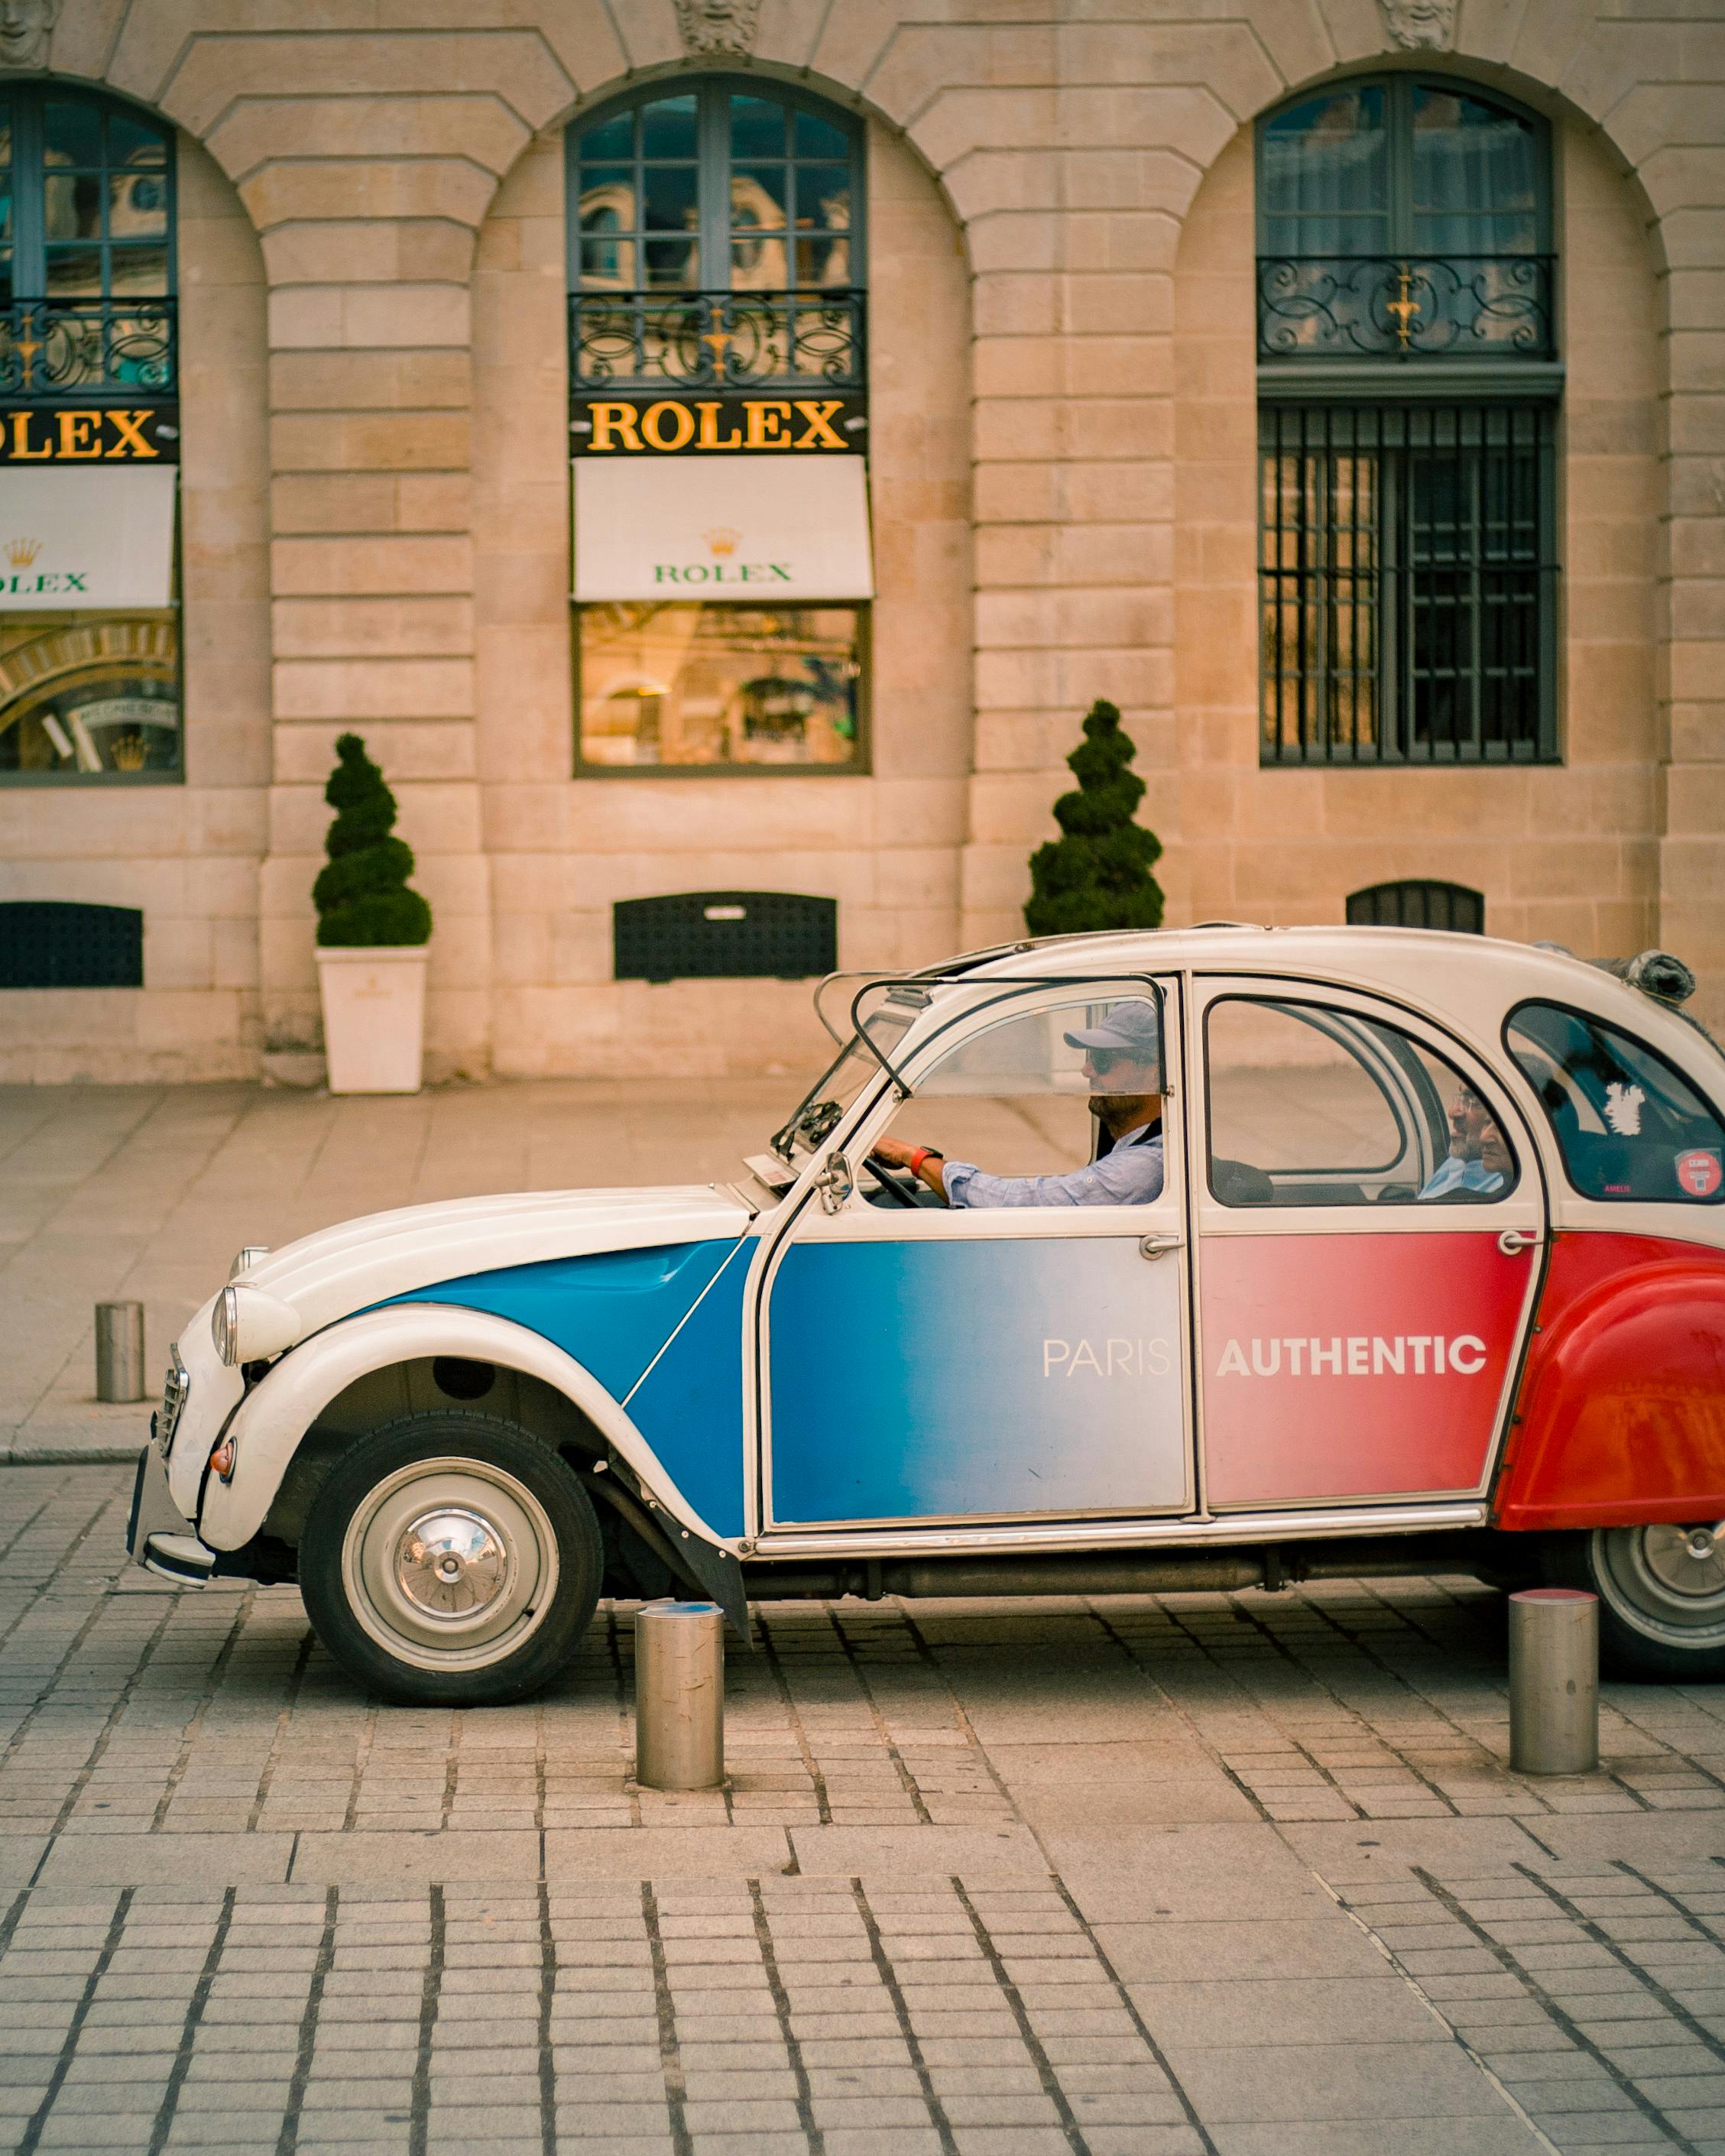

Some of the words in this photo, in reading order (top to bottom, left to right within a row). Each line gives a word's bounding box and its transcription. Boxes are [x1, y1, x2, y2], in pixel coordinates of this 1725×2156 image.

[0, 410, 160, 459] LEX
[587, 400, 849, 451] ROLEX
[0, 572, 88, 595] LEX
[653, 563, 793, 585] ROLEX
[1042, 1337, 1172, 1378] PARIS
[1216, 1334, 1487, 1377] AUTHENTIC
